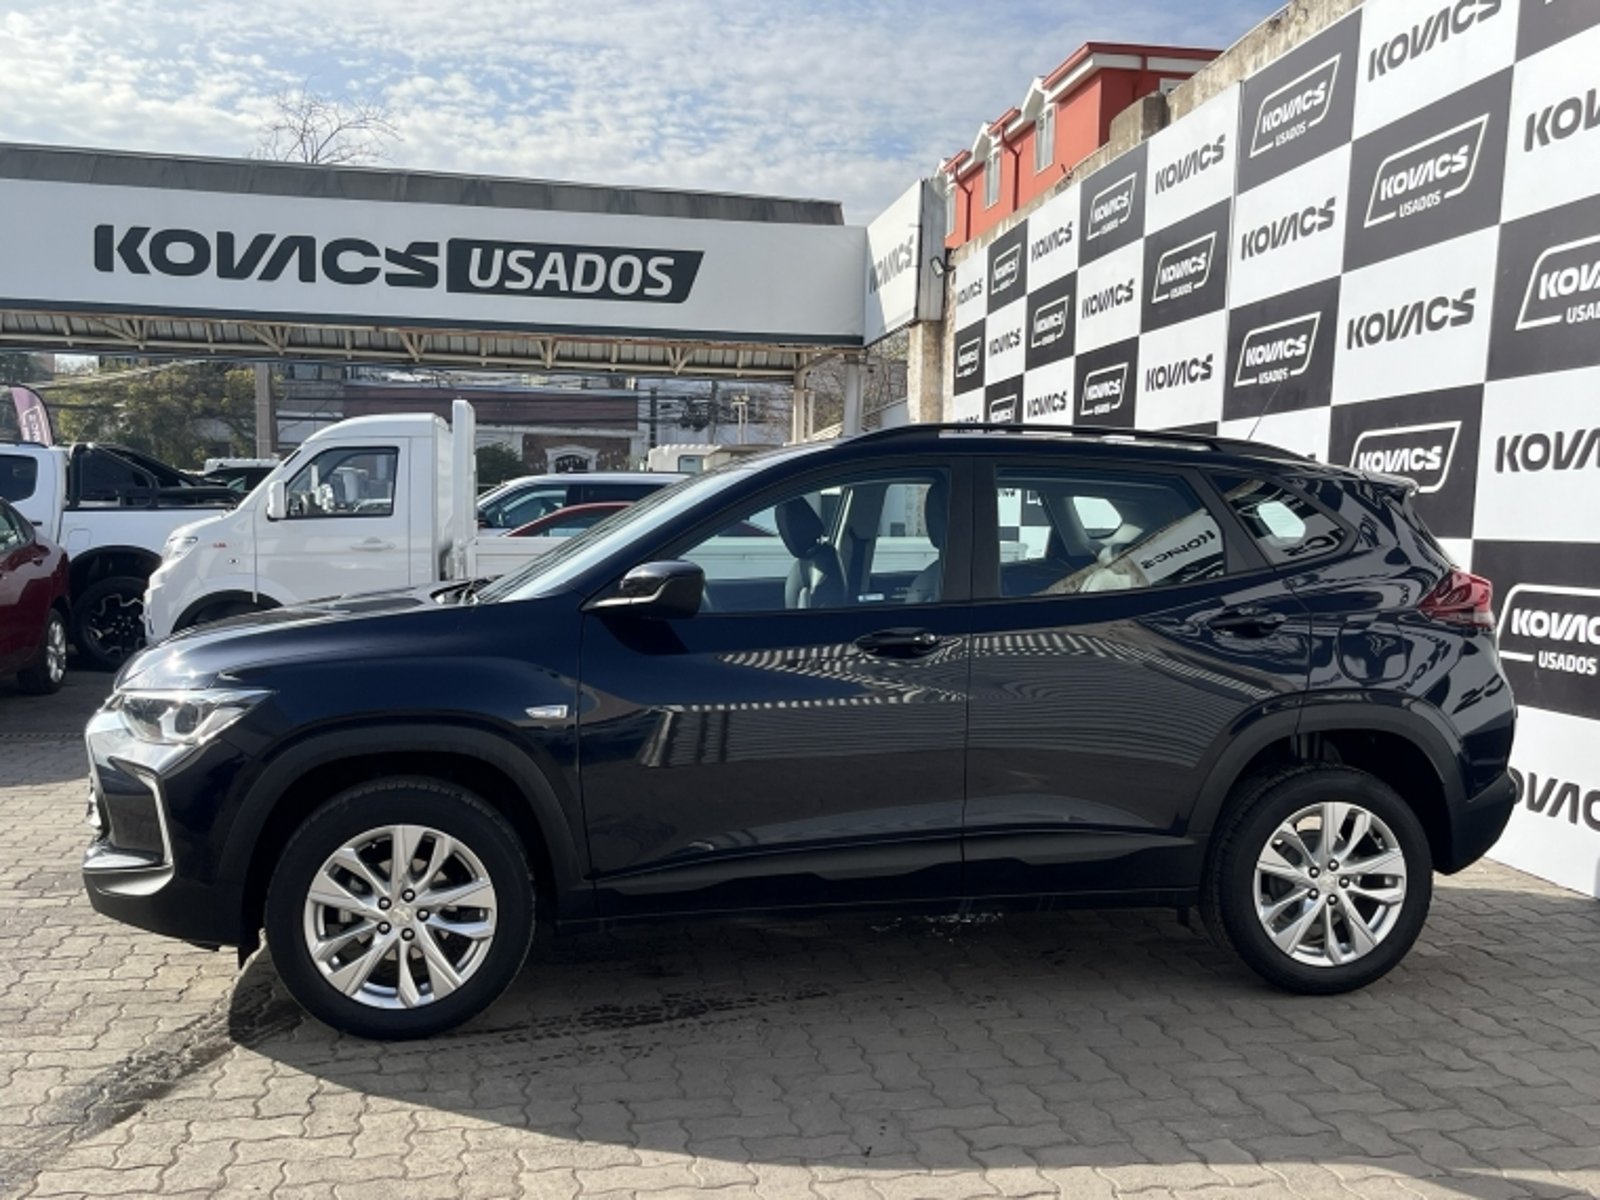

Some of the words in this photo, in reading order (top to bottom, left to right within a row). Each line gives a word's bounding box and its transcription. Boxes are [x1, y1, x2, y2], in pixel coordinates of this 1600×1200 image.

[1367, 0, 1502, 82] KOVACS
[1261, 81, 1327, 134] KOVACS
[1524, 87, 1600, 152] KOV
[1275, 122, 1307, 147] USADOS
[1155, 133, 1225, 195] KOVACS
[1379, 145, 1469, 201] KOVACS
[1399, 191, 1441, 219] USADOS
[1241, 196, 1336, 260] KOVACS
[94, 224, 440, 289] KOVACS
[468, 248, 675, 296] USADOS
[1160, 252, 1207, 285] KOVACS
[1539, 260, 1600, 300] KOV
[1081, 278, 1135, 319] KOVACS
[1347, 287, 1476, 350] KOVACS
[1566, 301, 1600, 324] USA
[1245, 334, 1308, 367] KOVACS
[1145, 353, 1214, 392] KOVACS
[1358, 446, 1442, 472] KOVACS
[1495, 428, 1600, 474] KOVA
[1511, 608, 1600, 645] KOVAC
[1538, 651, 1597, 675] USADOS
